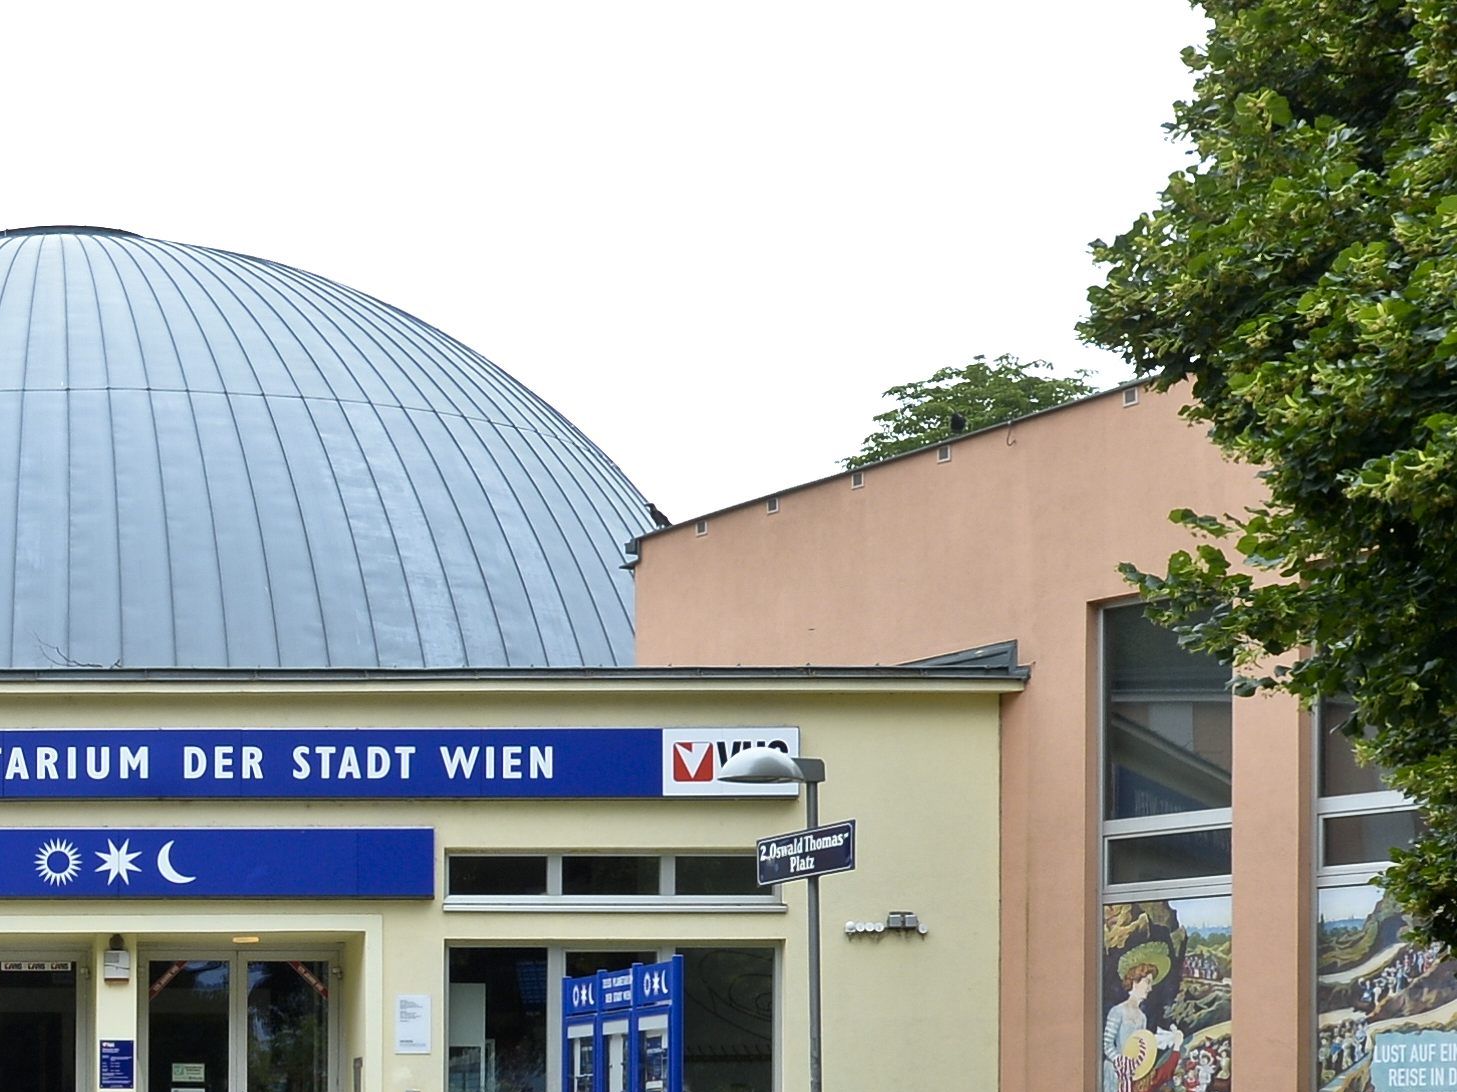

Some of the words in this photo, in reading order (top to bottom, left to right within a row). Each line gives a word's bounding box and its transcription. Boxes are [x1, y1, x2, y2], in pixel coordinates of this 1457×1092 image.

[183, 745, 264, 780] DER
[292, 745, 417, 779] STADT
[440, 745, 555, 779] WIEN
[769, 837, 803, 859] Oswald
[790, 855, 815, 873] Platz
[1374, 1044, 1406, 1063] LUST
[1410, 1043, 1436, 1062] AUF
[1388, 1068, 1427, 1087] REISE
[1430, 1067, 1444, 1086] IN
